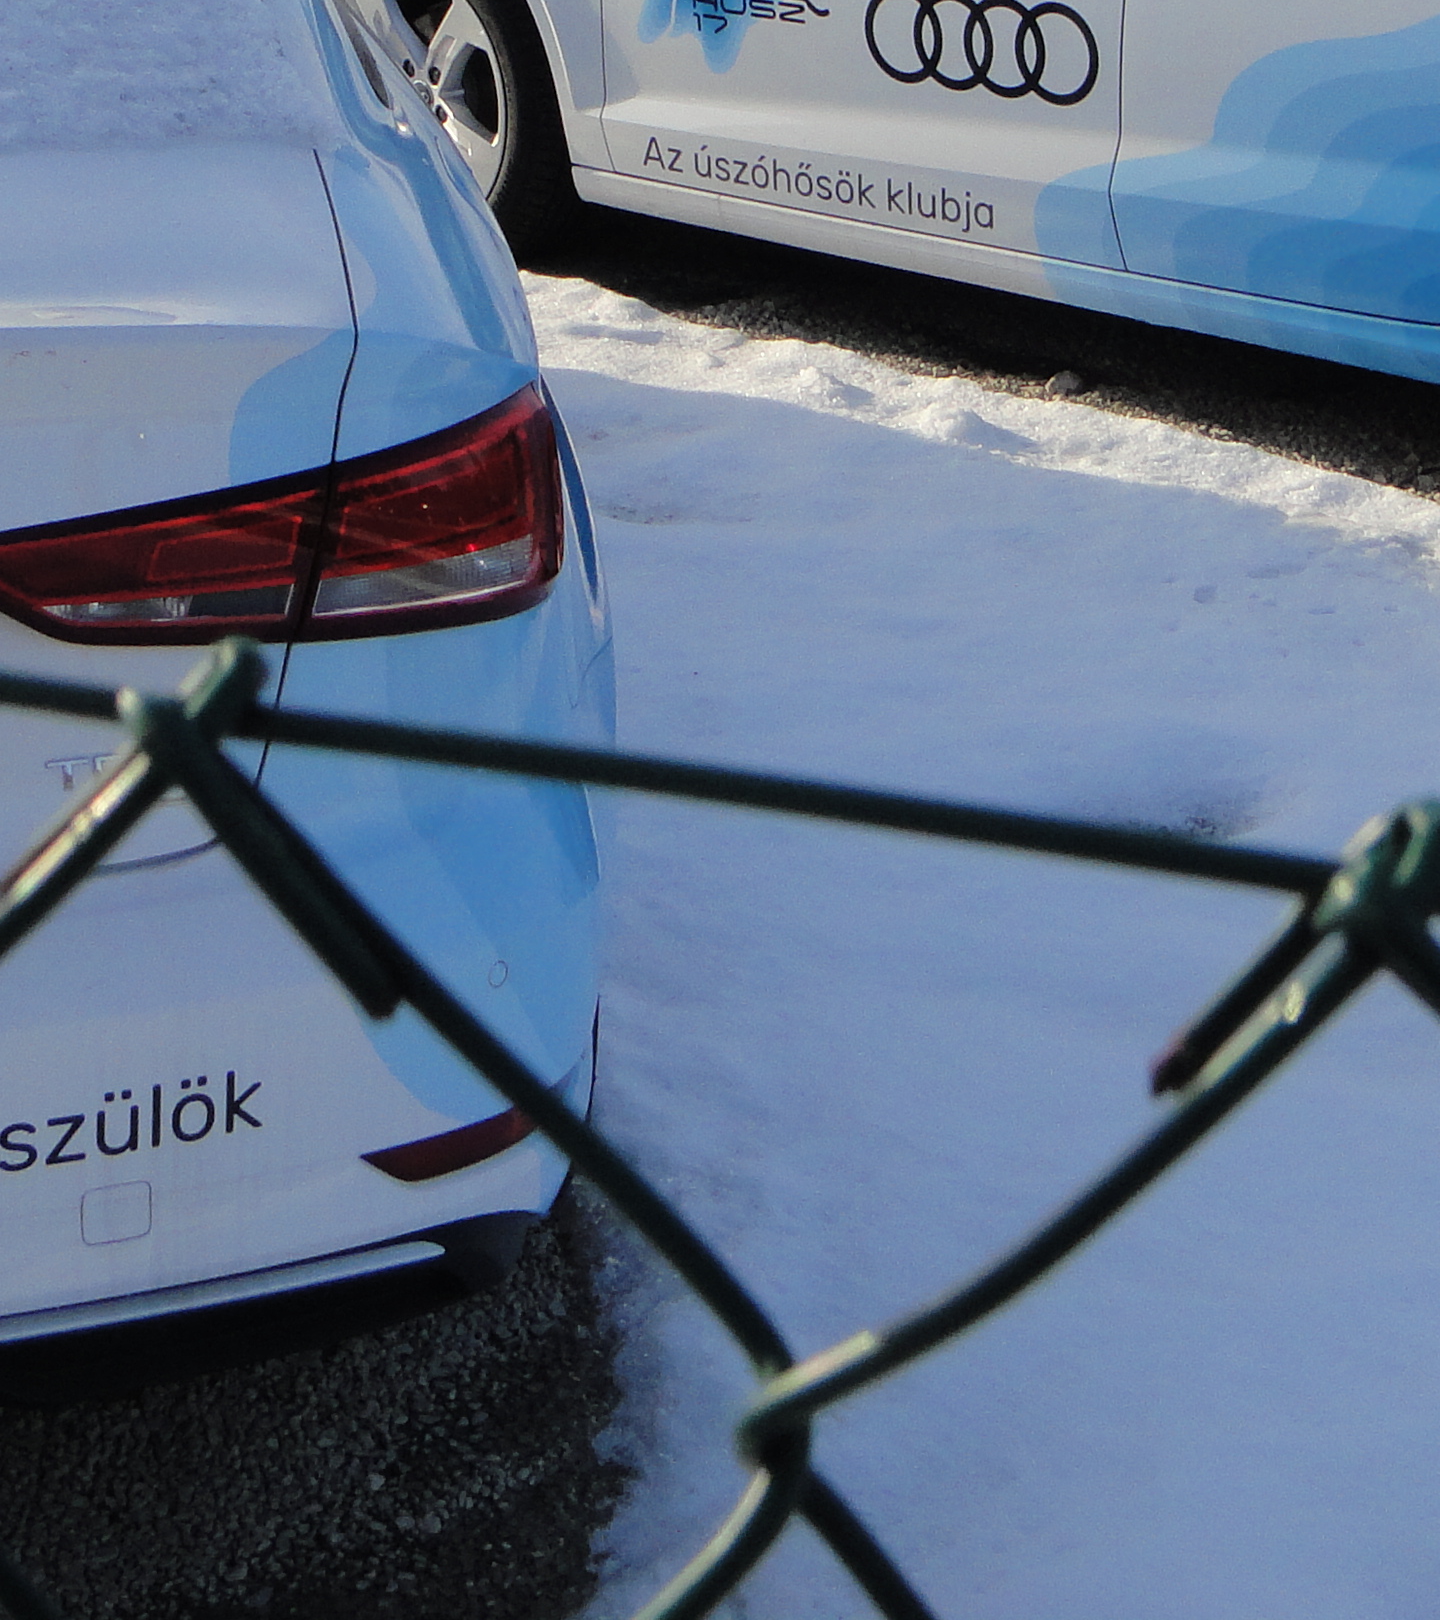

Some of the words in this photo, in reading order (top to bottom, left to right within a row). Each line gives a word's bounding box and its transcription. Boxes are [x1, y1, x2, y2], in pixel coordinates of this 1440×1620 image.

[643, 136, 684, 173] Az
[694, 145, 876, 209] úszóhősök
[887, 179, 994, 232] klubja
